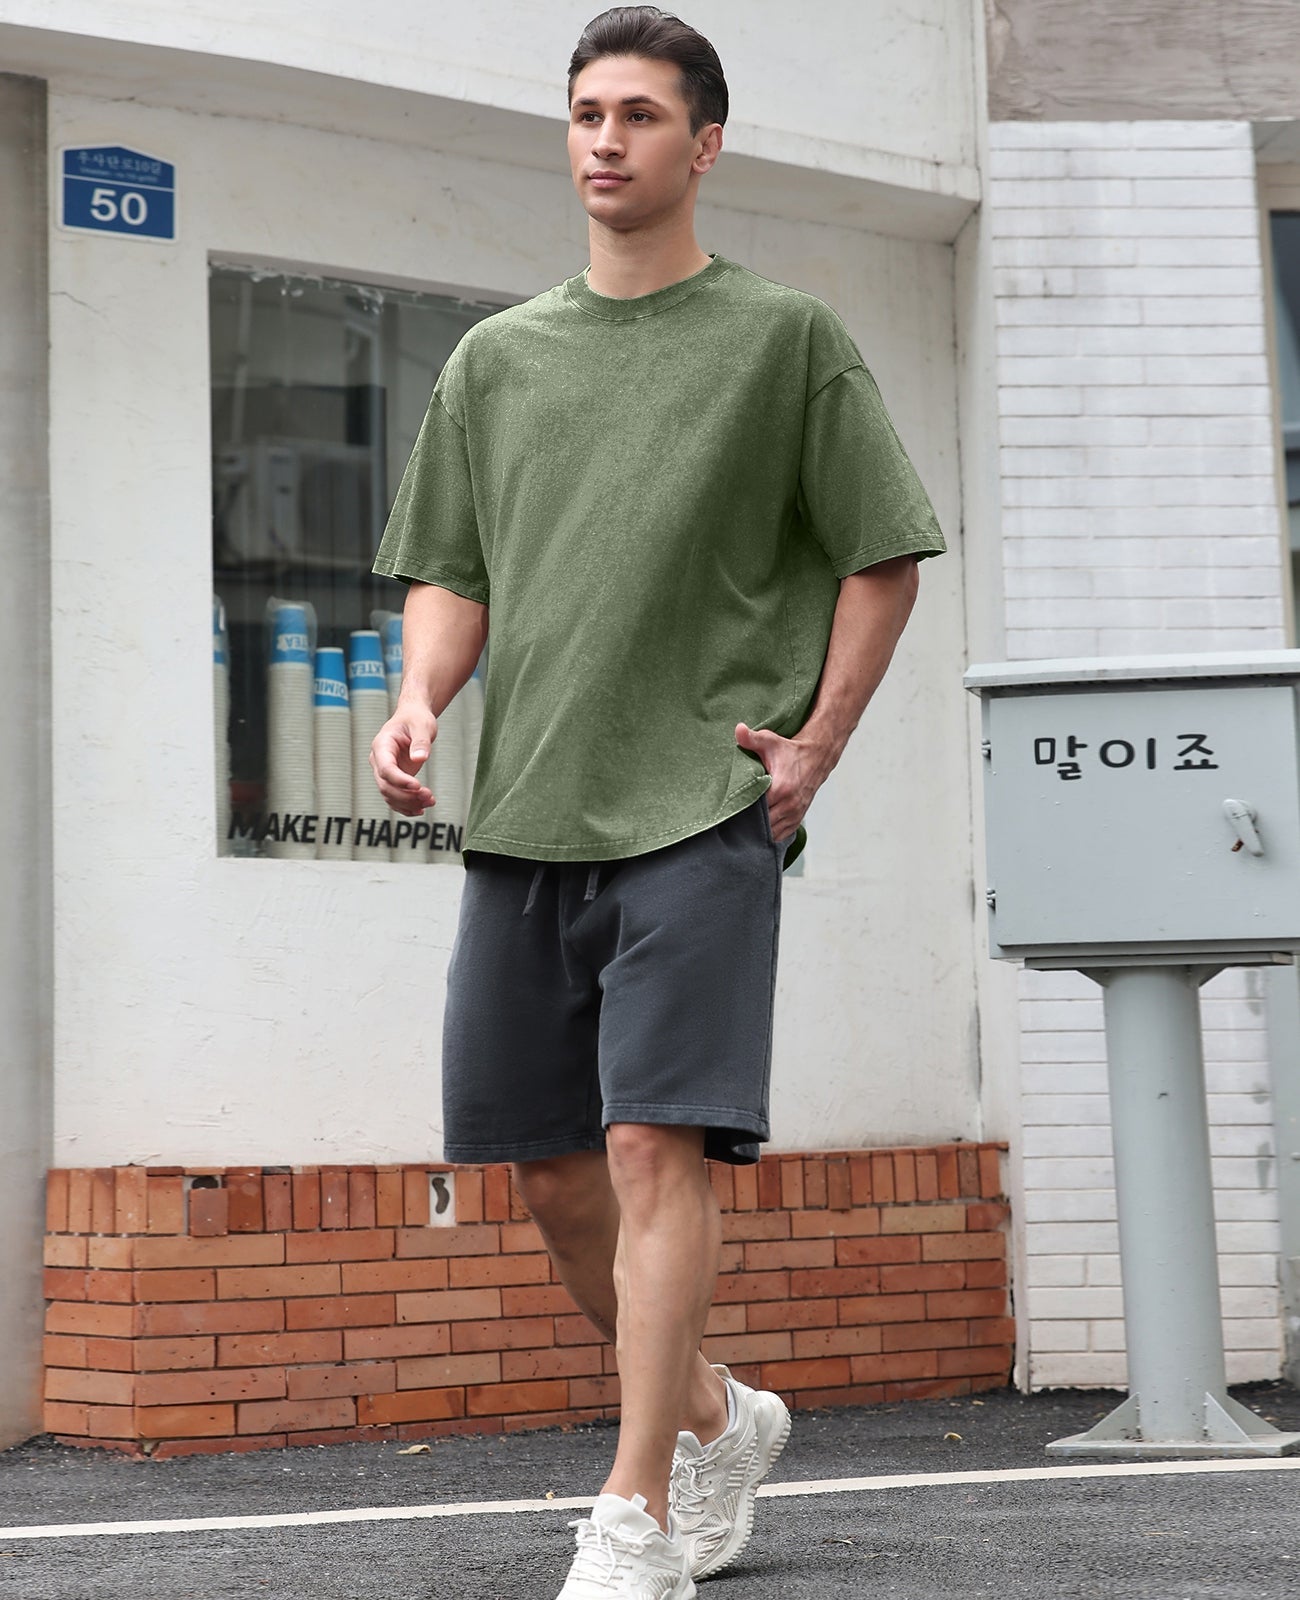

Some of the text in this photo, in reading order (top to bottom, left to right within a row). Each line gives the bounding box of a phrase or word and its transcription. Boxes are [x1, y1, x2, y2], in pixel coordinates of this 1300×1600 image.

[90, 188, 147, 226] 50
[1034, 733, 1219, 780] 말이죠
[228, 812, 463, 853] MAKE IT HAPPEN
